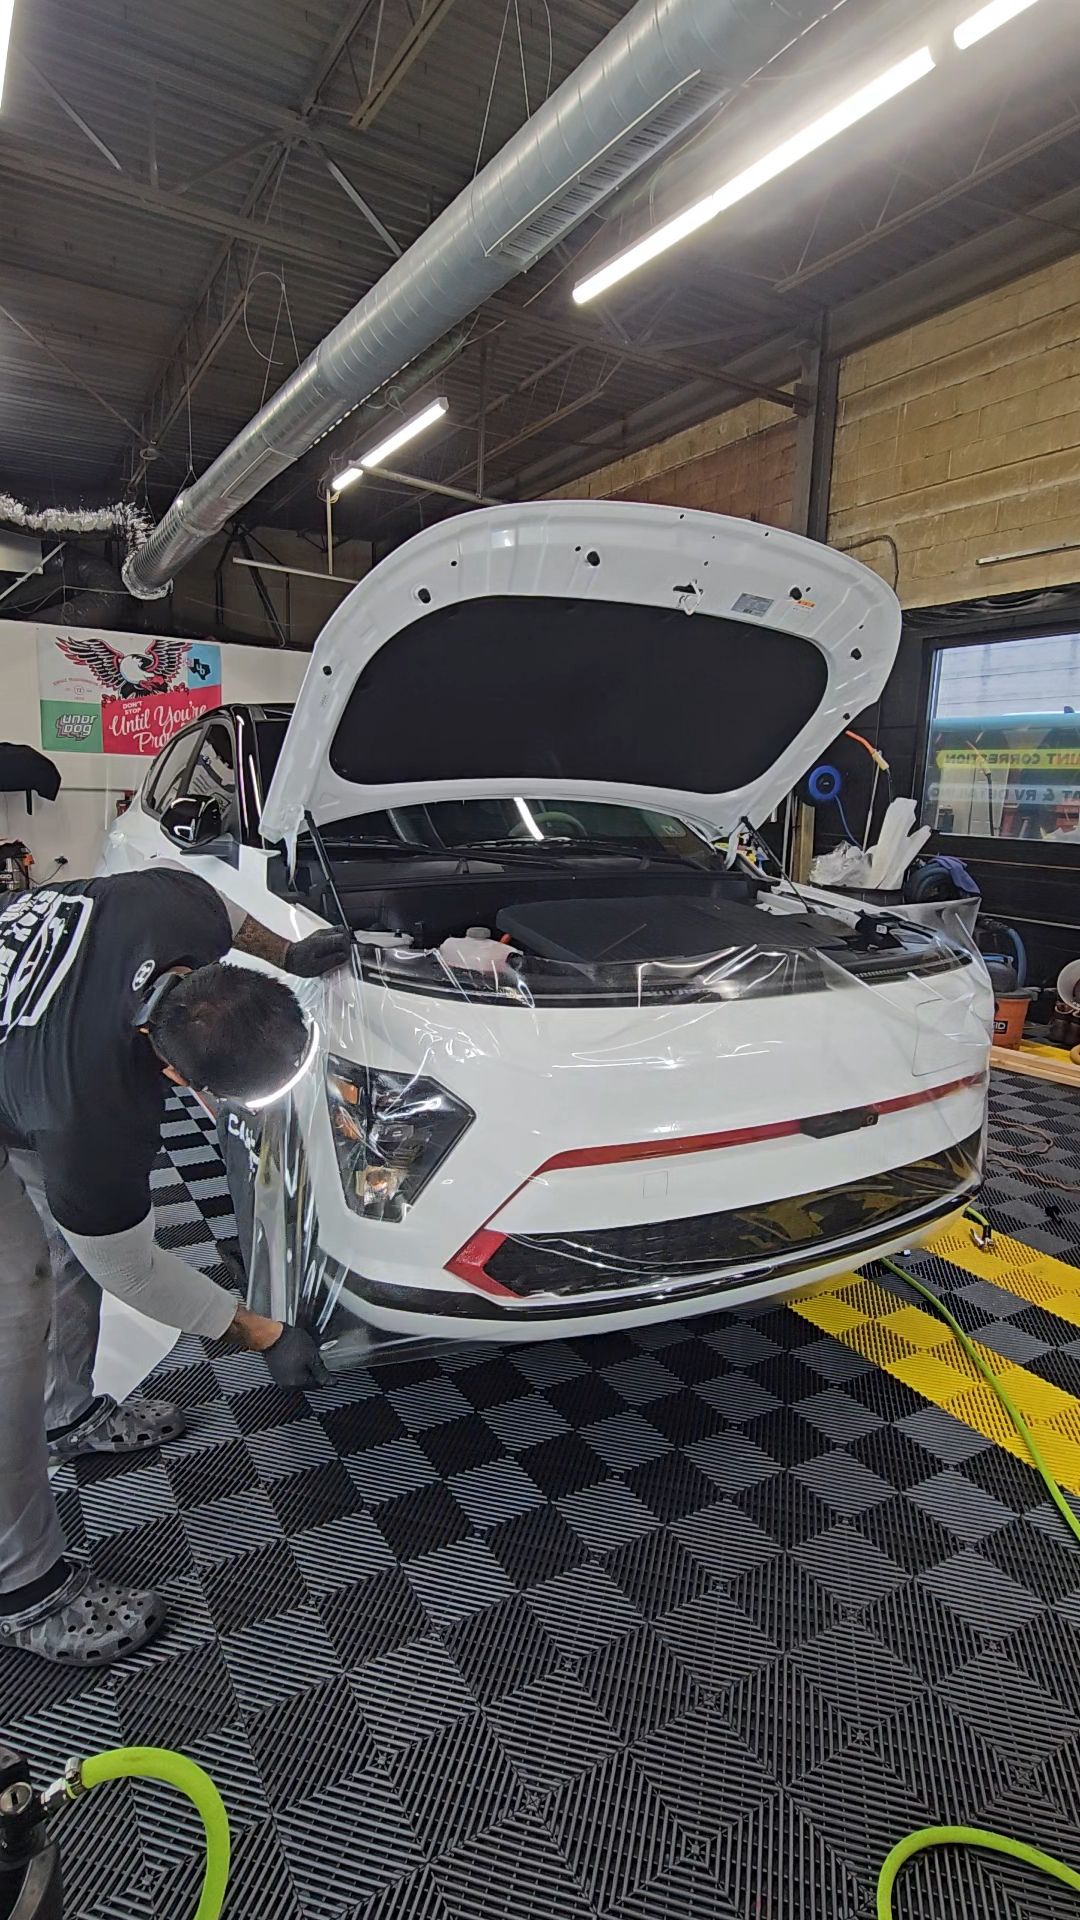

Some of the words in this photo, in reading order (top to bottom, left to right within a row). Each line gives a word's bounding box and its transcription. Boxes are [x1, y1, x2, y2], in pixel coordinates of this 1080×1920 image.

[122, 701, 143, 710] DON'T
[124, 708, 142, 716] STOP
[109, 708, 151, 737] Until
[154, 701, 207, 735] You're
[133, 731, 176, 753] Pro
